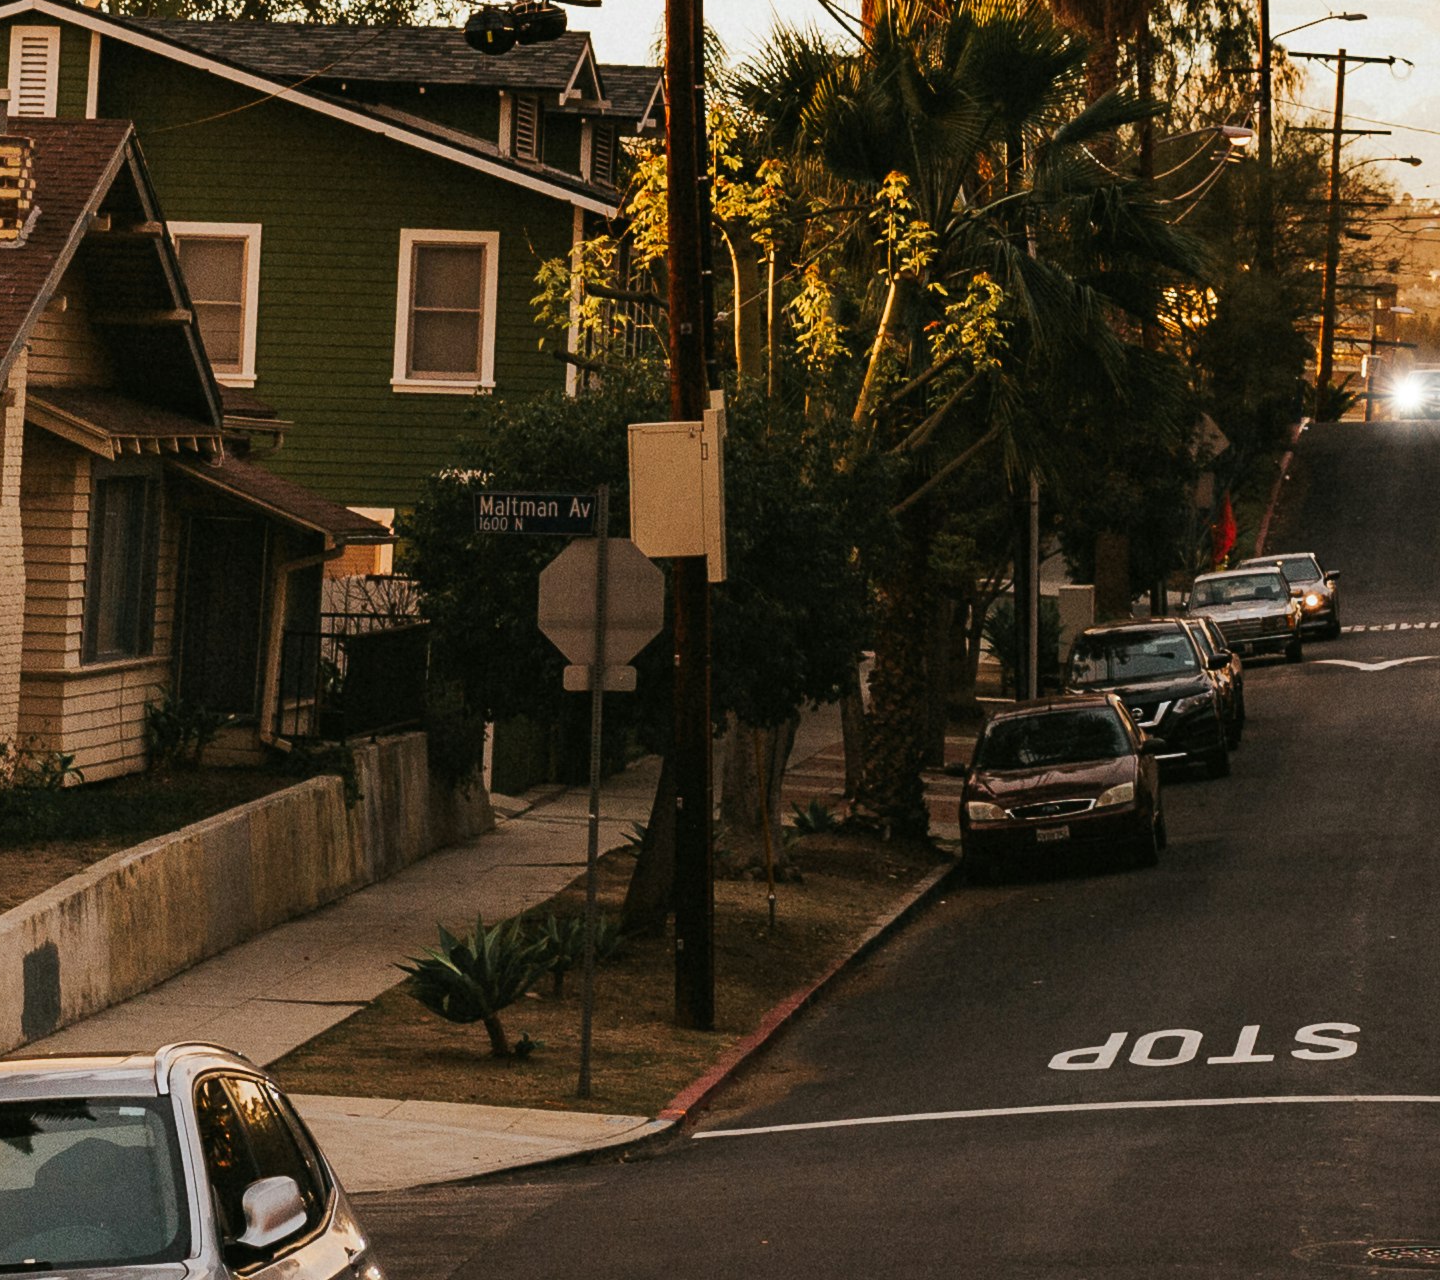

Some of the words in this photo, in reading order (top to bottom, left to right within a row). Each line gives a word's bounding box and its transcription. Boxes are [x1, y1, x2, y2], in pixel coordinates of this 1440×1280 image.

[479, 495, 558, 518] Maltman
[569, 497, 591, 518] Av
[479, 517, 508, 531] 1600
[514, 517, 523, 531] N
[1047, 1022, 1361, 1071] STOP
